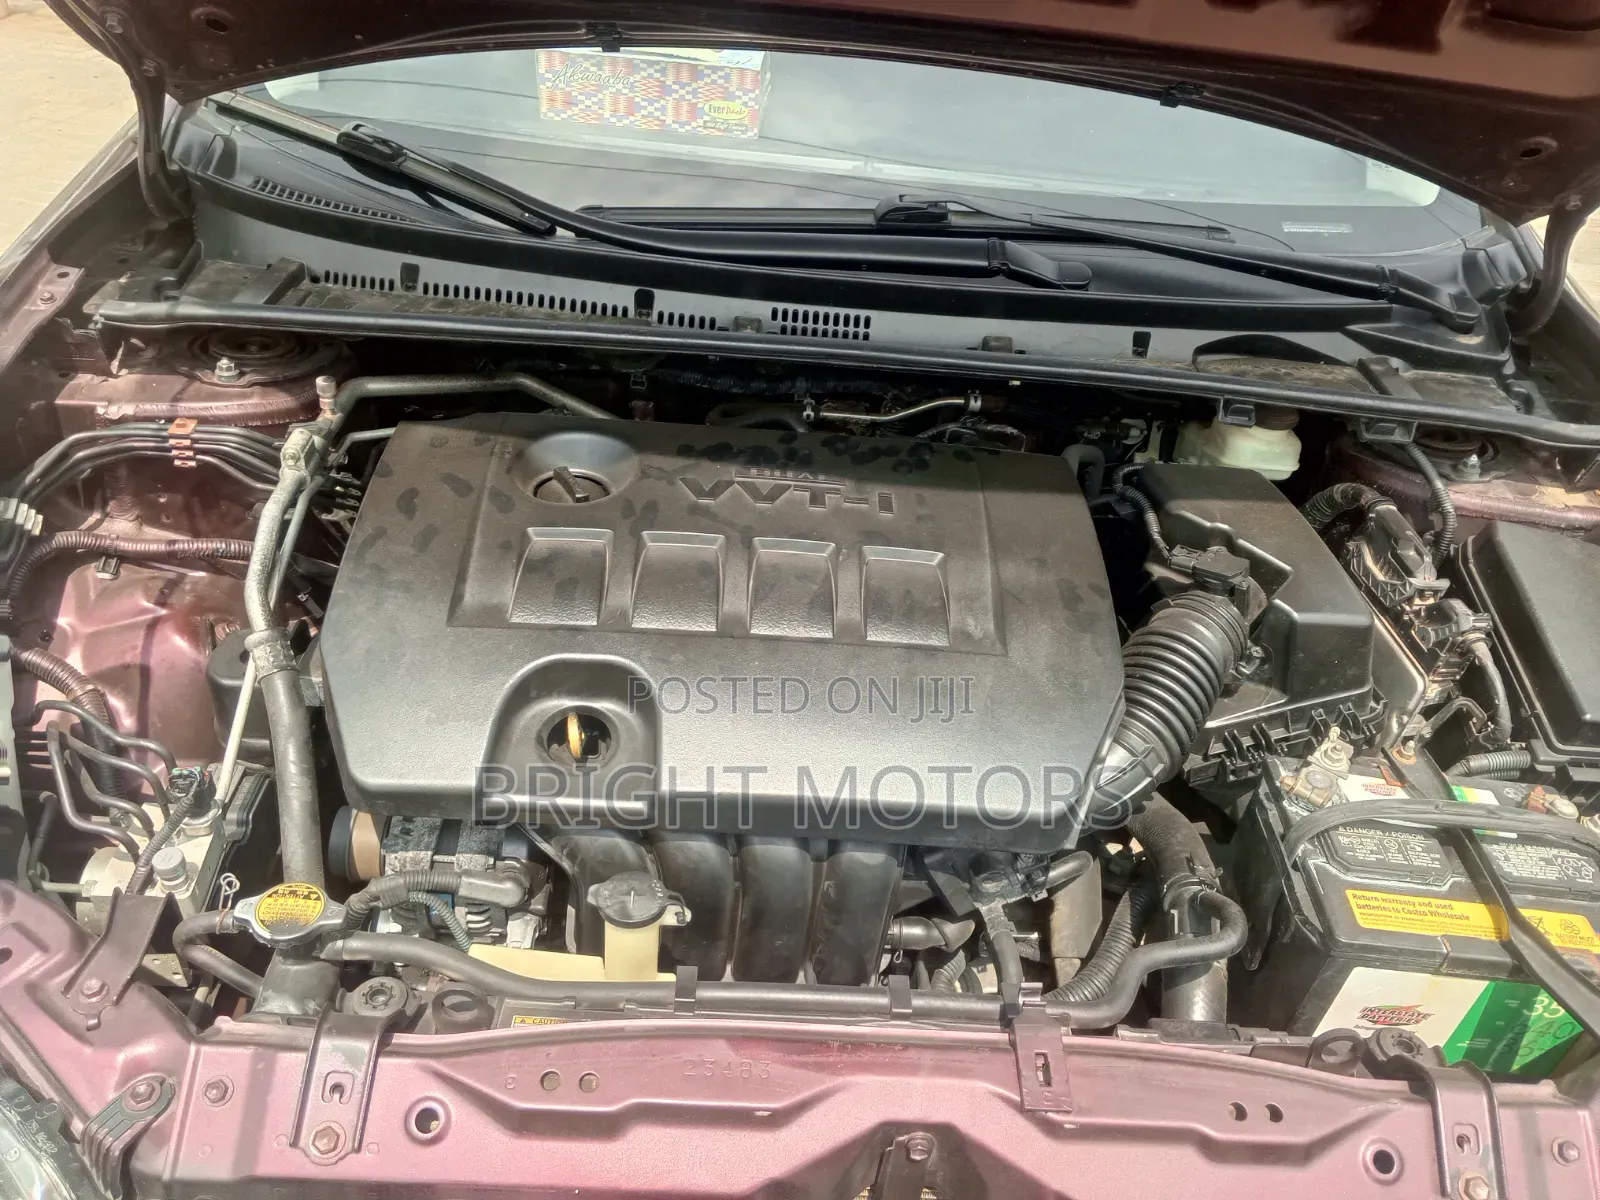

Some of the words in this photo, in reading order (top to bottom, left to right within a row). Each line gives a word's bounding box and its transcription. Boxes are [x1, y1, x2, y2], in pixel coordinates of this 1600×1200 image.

[550, 61, 632, 89] Akwaaba
[1346, 826, 1383, 836] DANGER
[1391, 831, 1425, 840] POISON
[1352, 893, 1382, 902] Return
[1381, 897, 1416, 908] warranty
[1418, 900, 1433, 908] and
[1435, 902, 1454, 910] used
[1356, 902, 1392, 912] batteries
[1402, 907, 1428, 917] Costco
[1429, 911, 1471, 921] Wholesale
[1361, 1006, 1432, 1020] INTERSTATE
[1523, 996, 1565, 1018] 35
[1360, 1013, 1422, 1024] BATTERIES
